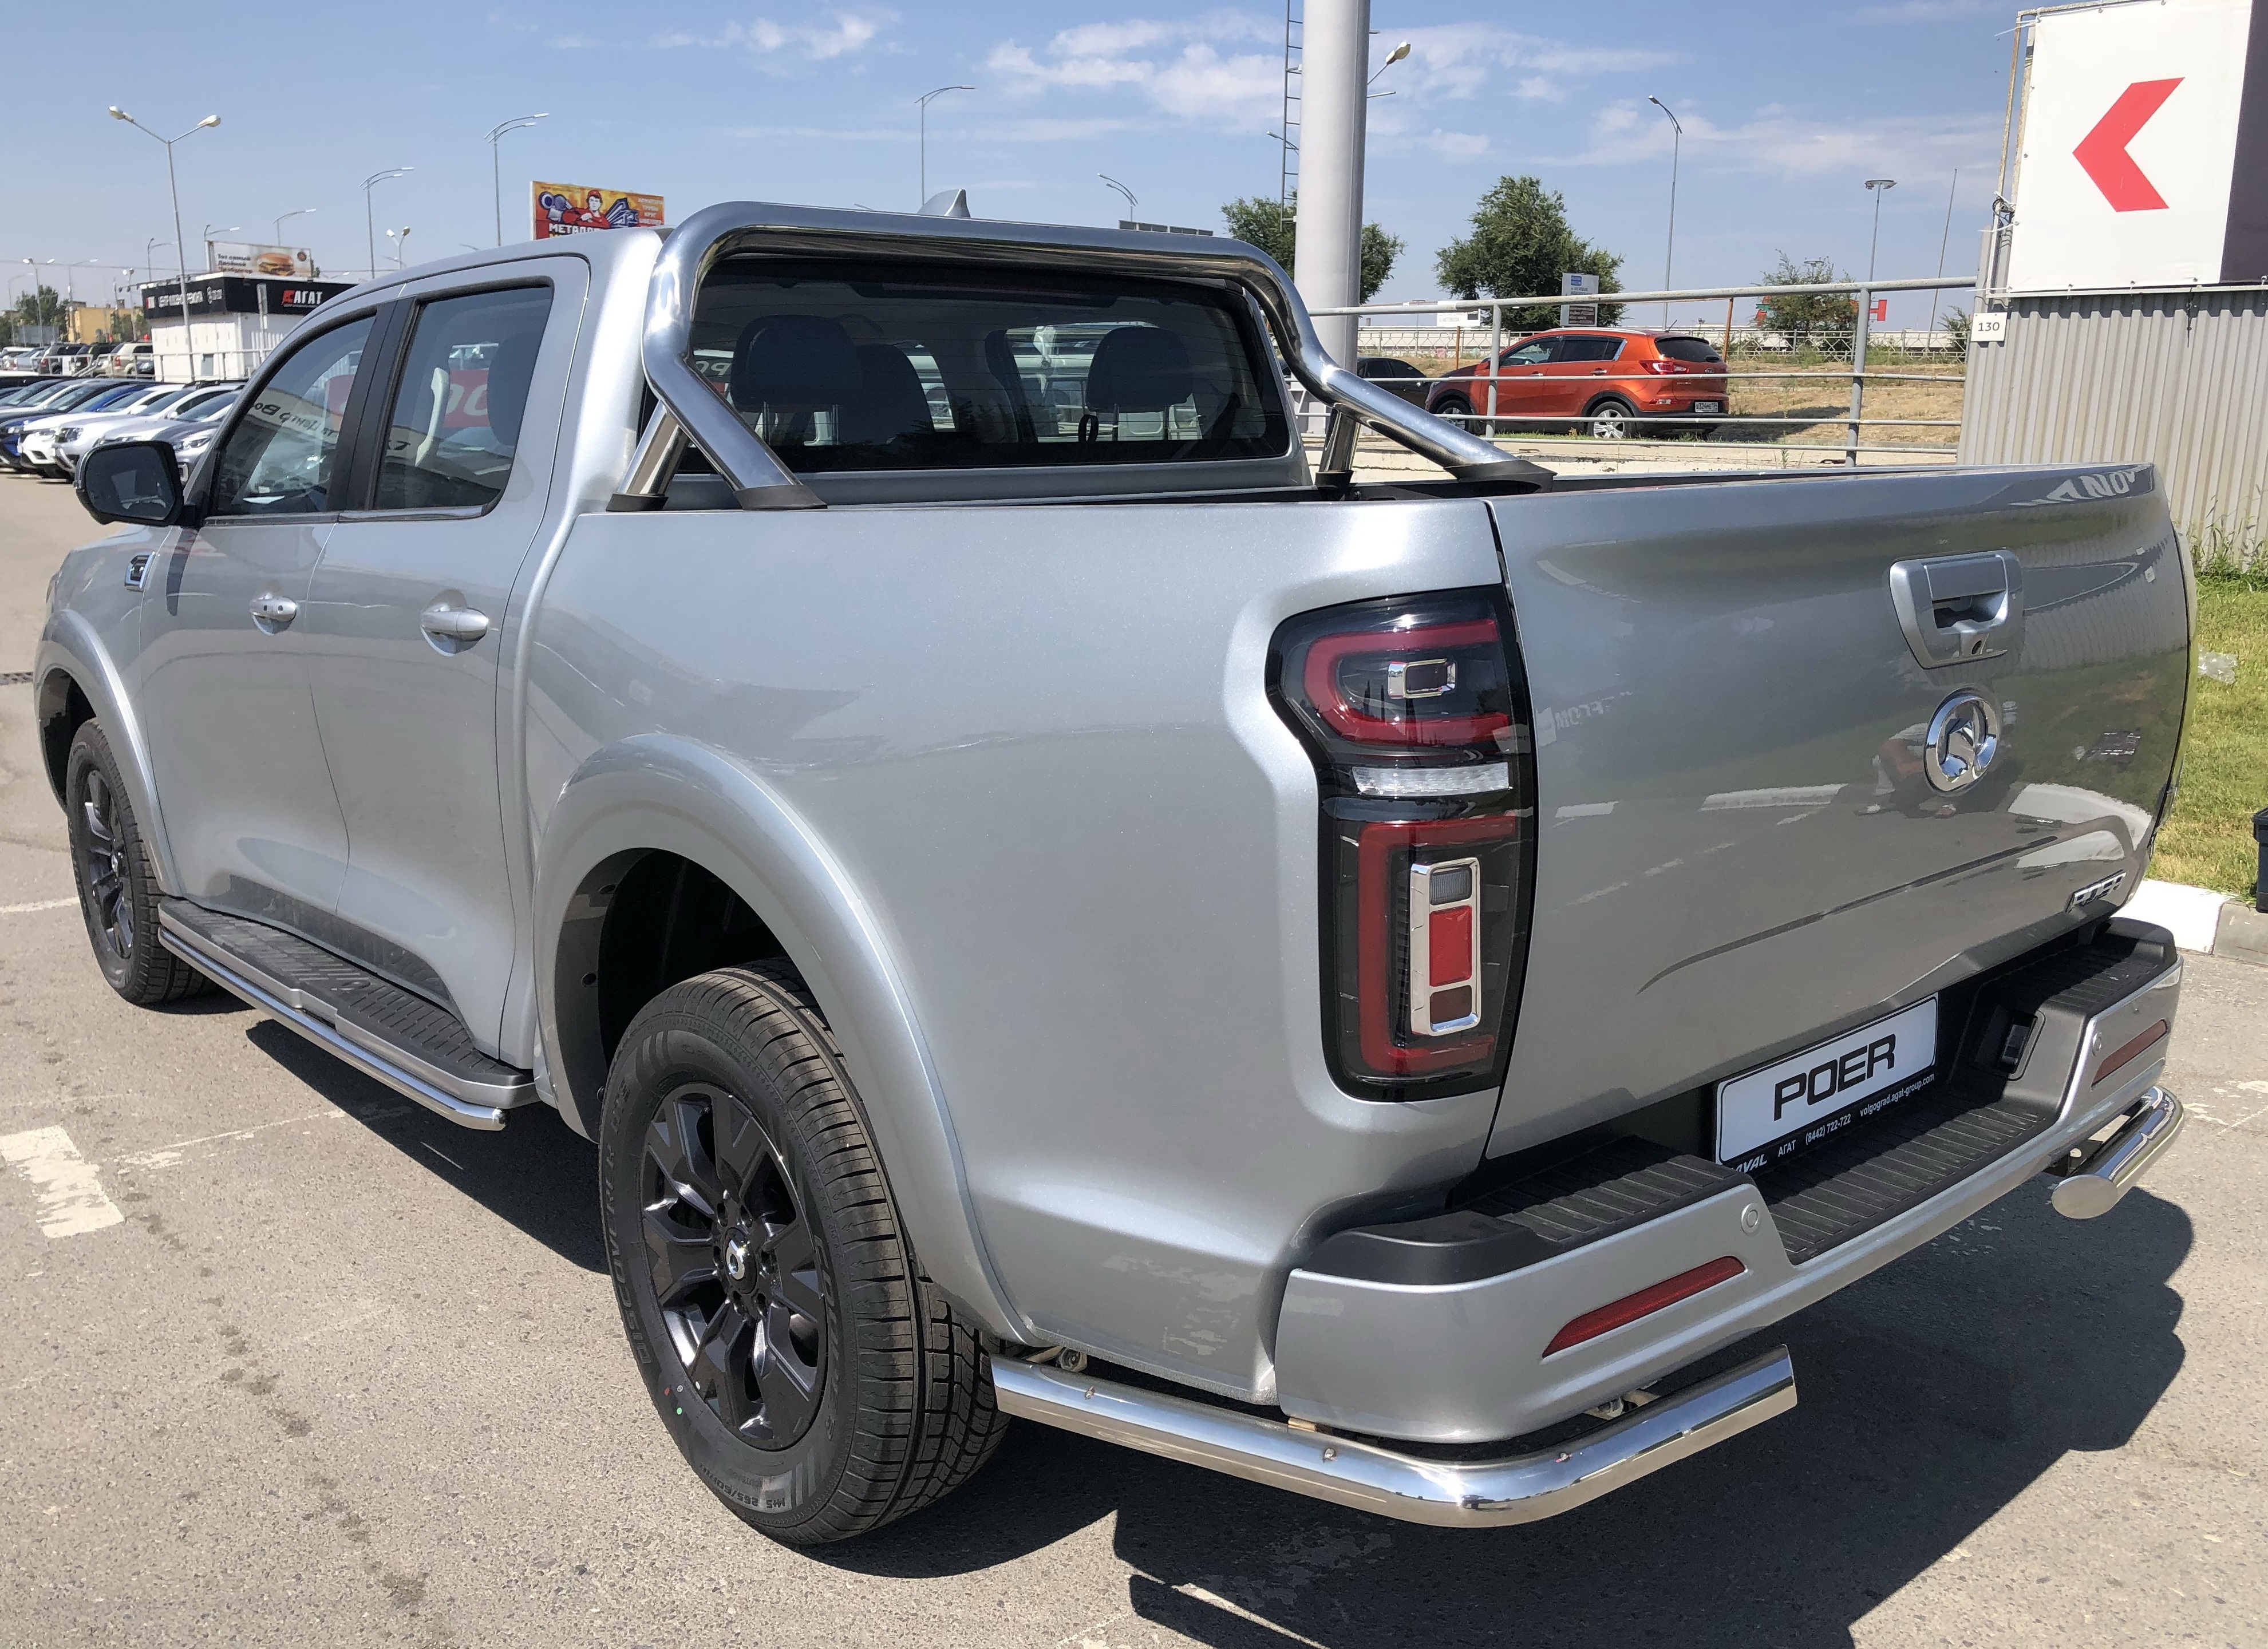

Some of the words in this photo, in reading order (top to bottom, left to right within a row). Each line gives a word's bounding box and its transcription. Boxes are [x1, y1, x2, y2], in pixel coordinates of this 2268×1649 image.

[294, 290, 323, 305] АГАТ
[1978, 322, 2000, 332] 130
[1774, 1033, 1896, 1122] POER
[1731, 1153, 1768, 1173] AVAL
[1777, 1140, 1796, 1157] АГАТ
[1805, 1125, 1826, 1145] (8442)
[1827, 1113, 1851, 1134] 722-722
[1860, 1073, 1934, 1117] volgograd.agat-group.com
[766, 1497, 786, 1509] M+S
